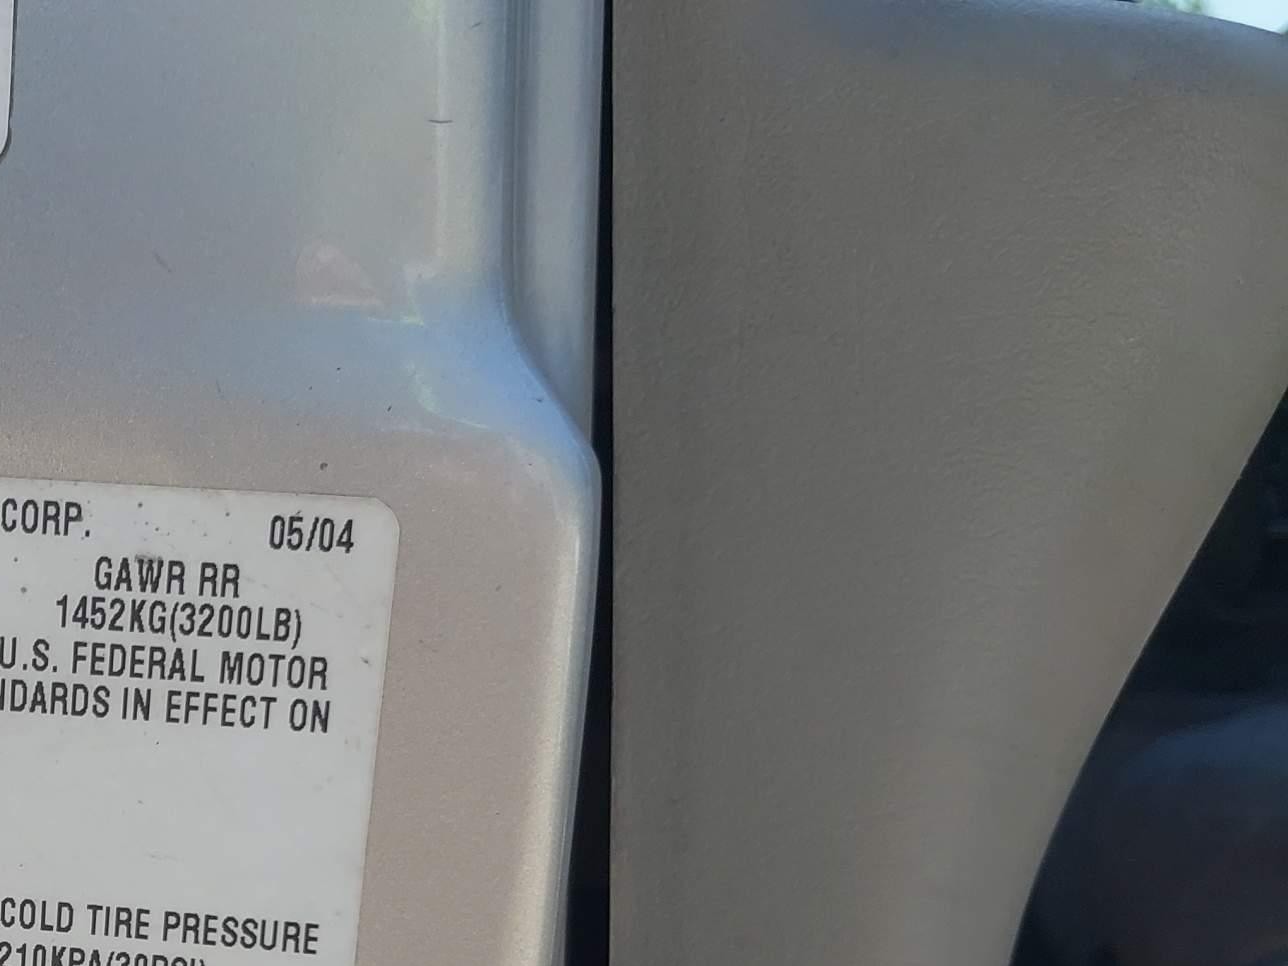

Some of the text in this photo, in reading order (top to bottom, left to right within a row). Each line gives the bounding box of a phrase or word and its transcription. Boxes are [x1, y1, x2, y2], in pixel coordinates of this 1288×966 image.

[2, 498, 90, 537] CORP.
[269, 515, 354, 553] 05/04
[95, 556, 240, 598] GAWR RR
[56, 595, 302, 649] 1452KG(3200LB)
[0, 636, 57, 672] U.S.
[73, 641, 204, 682] FEDERAL
[220, 651, 328, 690] MOTOR
[122, 688, 151, 721] IN
[166, 690, 277, 729] EFFECT
[290, 699, 330, 733] ON
[0, 897, 74, 932] COLD
[87, 904, 150, 939] TIRE
[163, 911, 319, 954] PRESSURE
